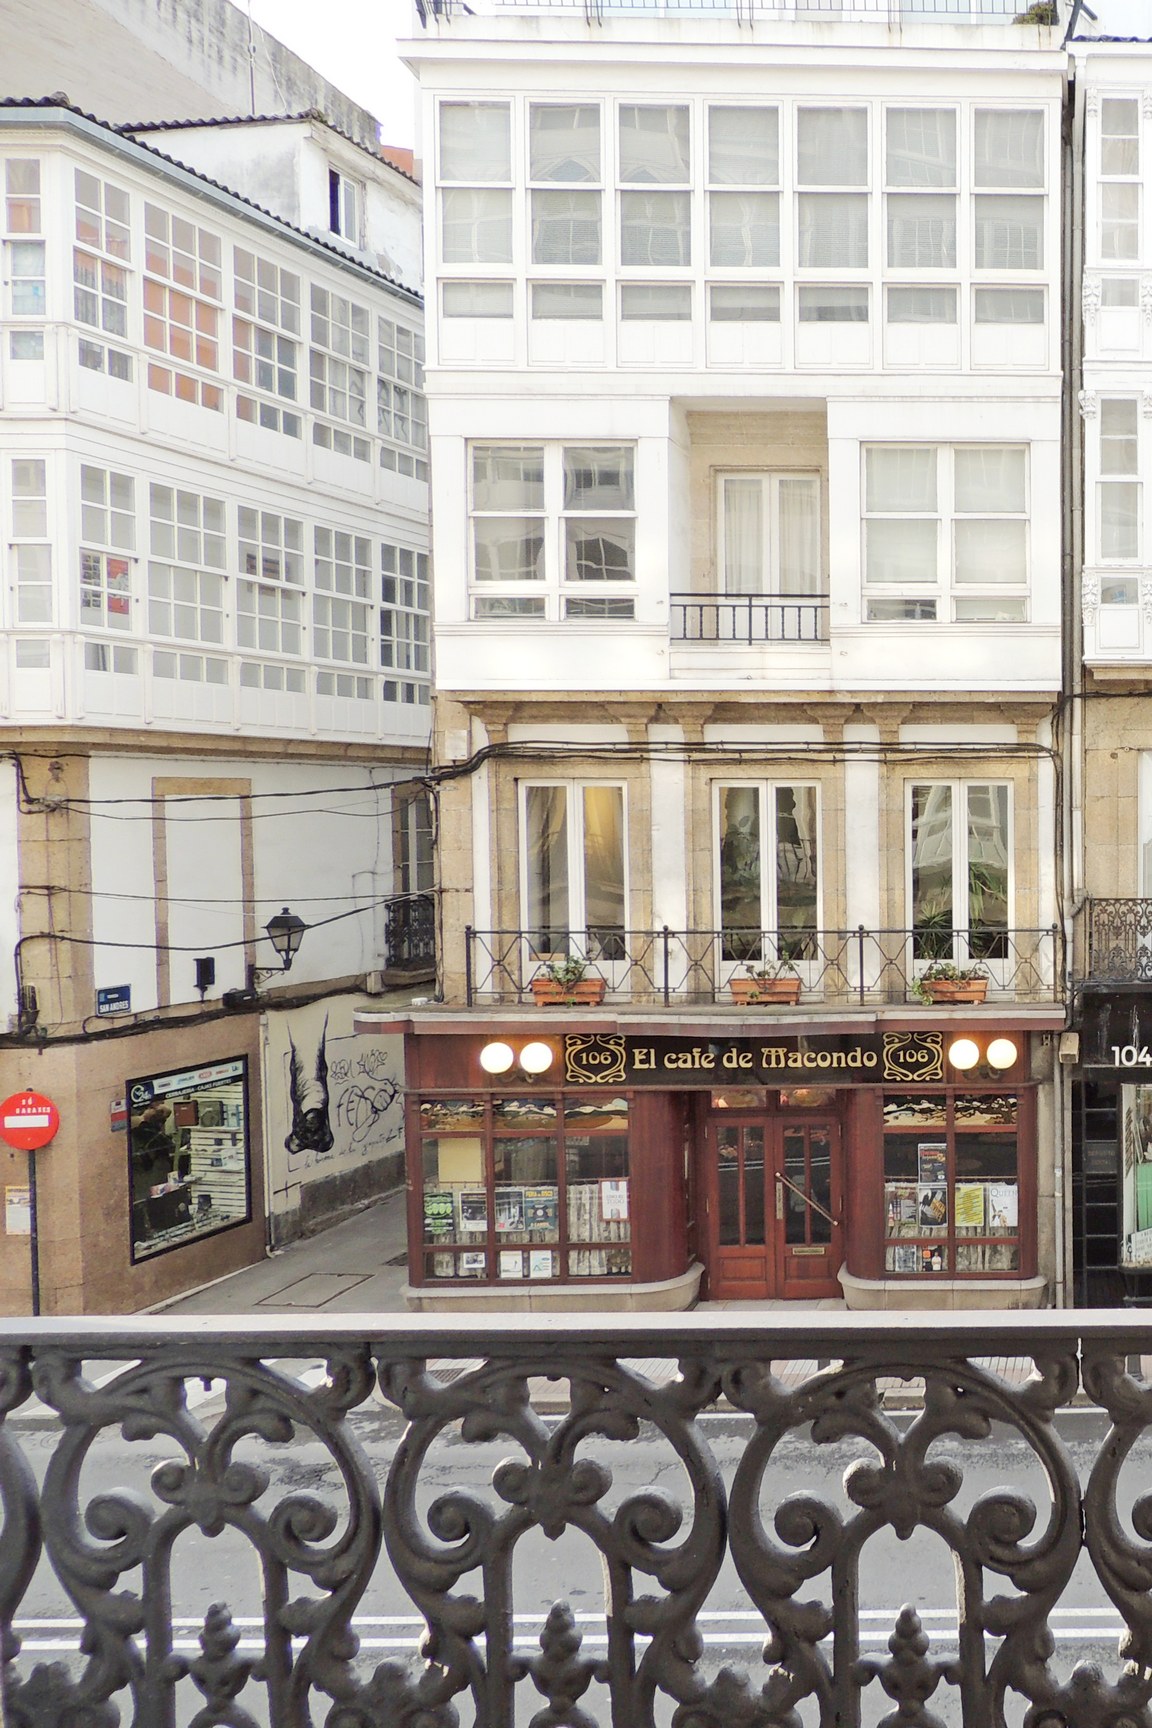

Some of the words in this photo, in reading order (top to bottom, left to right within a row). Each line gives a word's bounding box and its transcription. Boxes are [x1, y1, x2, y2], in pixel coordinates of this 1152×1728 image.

[580, 1052, 612, 1065] 106
[632, 1048, 656, 1069] El
[722, 1048, 753, 1069] de
[761, 1047, 877, 1068] Macondo
[897, 1049, 929, 1063] 106
[1111, 1046, 1152, 1067] 104
